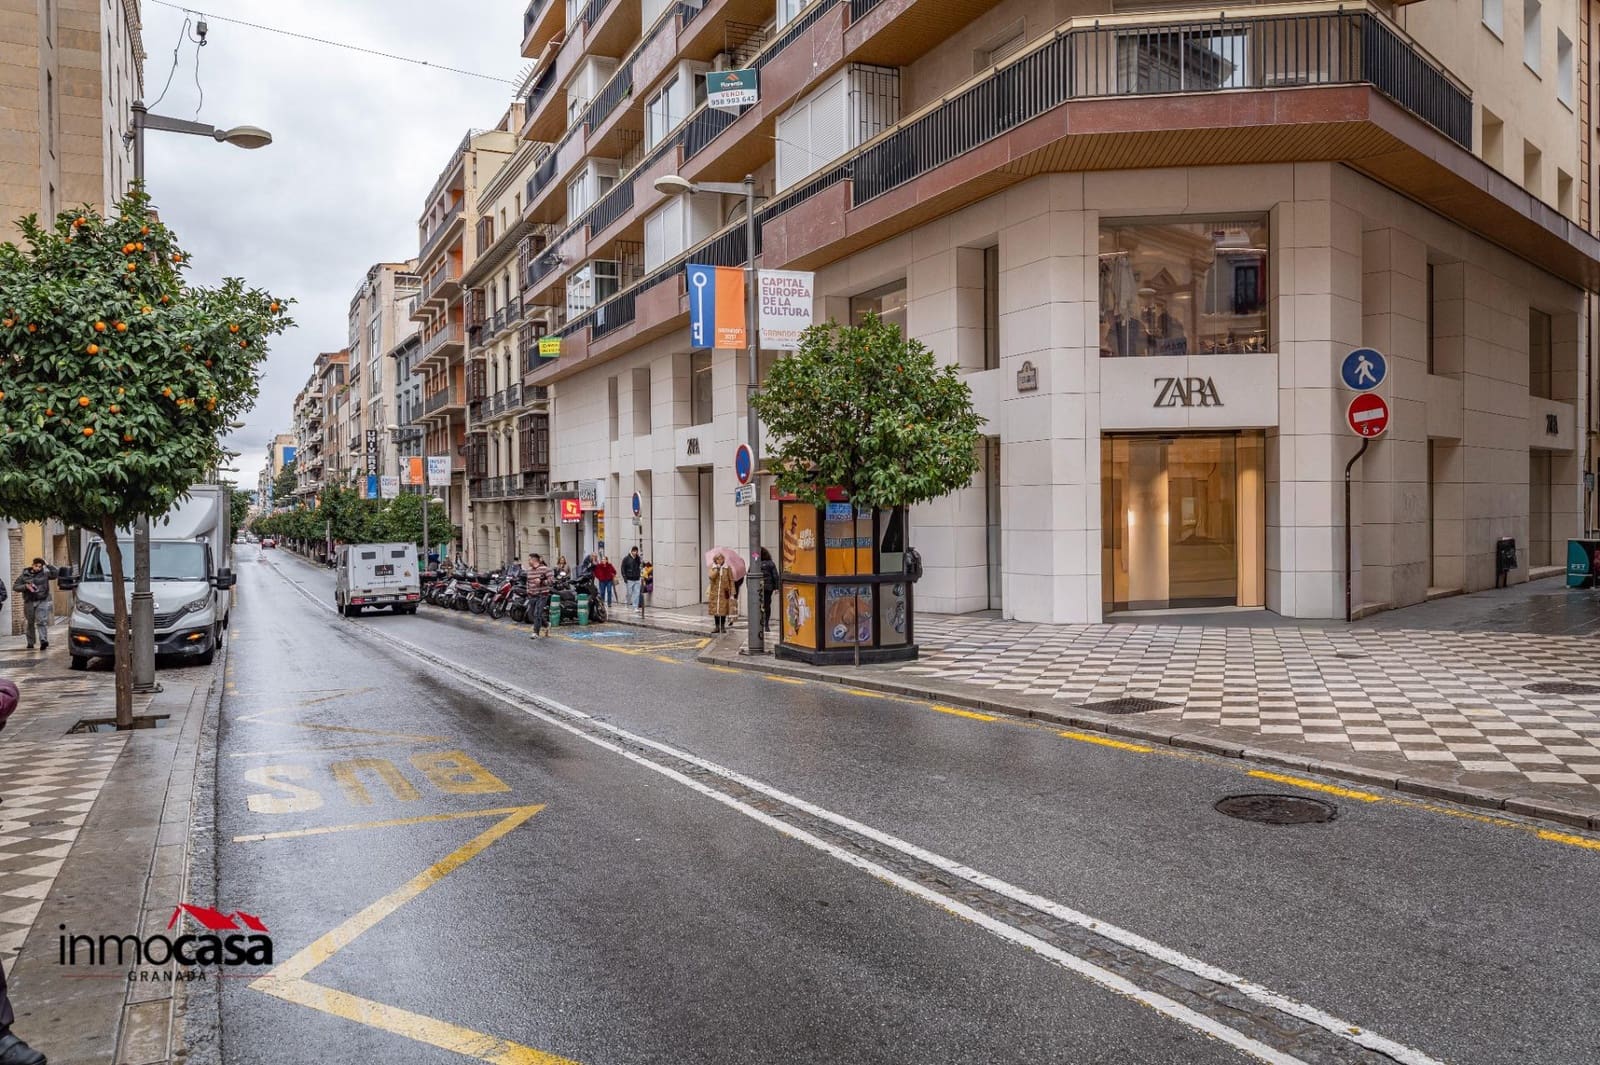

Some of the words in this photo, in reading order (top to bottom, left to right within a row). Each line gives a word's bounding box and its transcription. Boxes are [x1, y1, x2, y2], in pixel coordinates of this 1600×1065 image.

[711, 98, 725, 106] 958
[762, 277, 804, 288] CAPITAL
[762, 287, 810, 298] EUROPEA
[763, 296, 776, 305] DE
[778, 297, 791, 306] LA
[763, 306, 810, 317] CULTURA
[1153, 376, 1225, 407] ZARA
[244, 750, 513, 814] BUS
